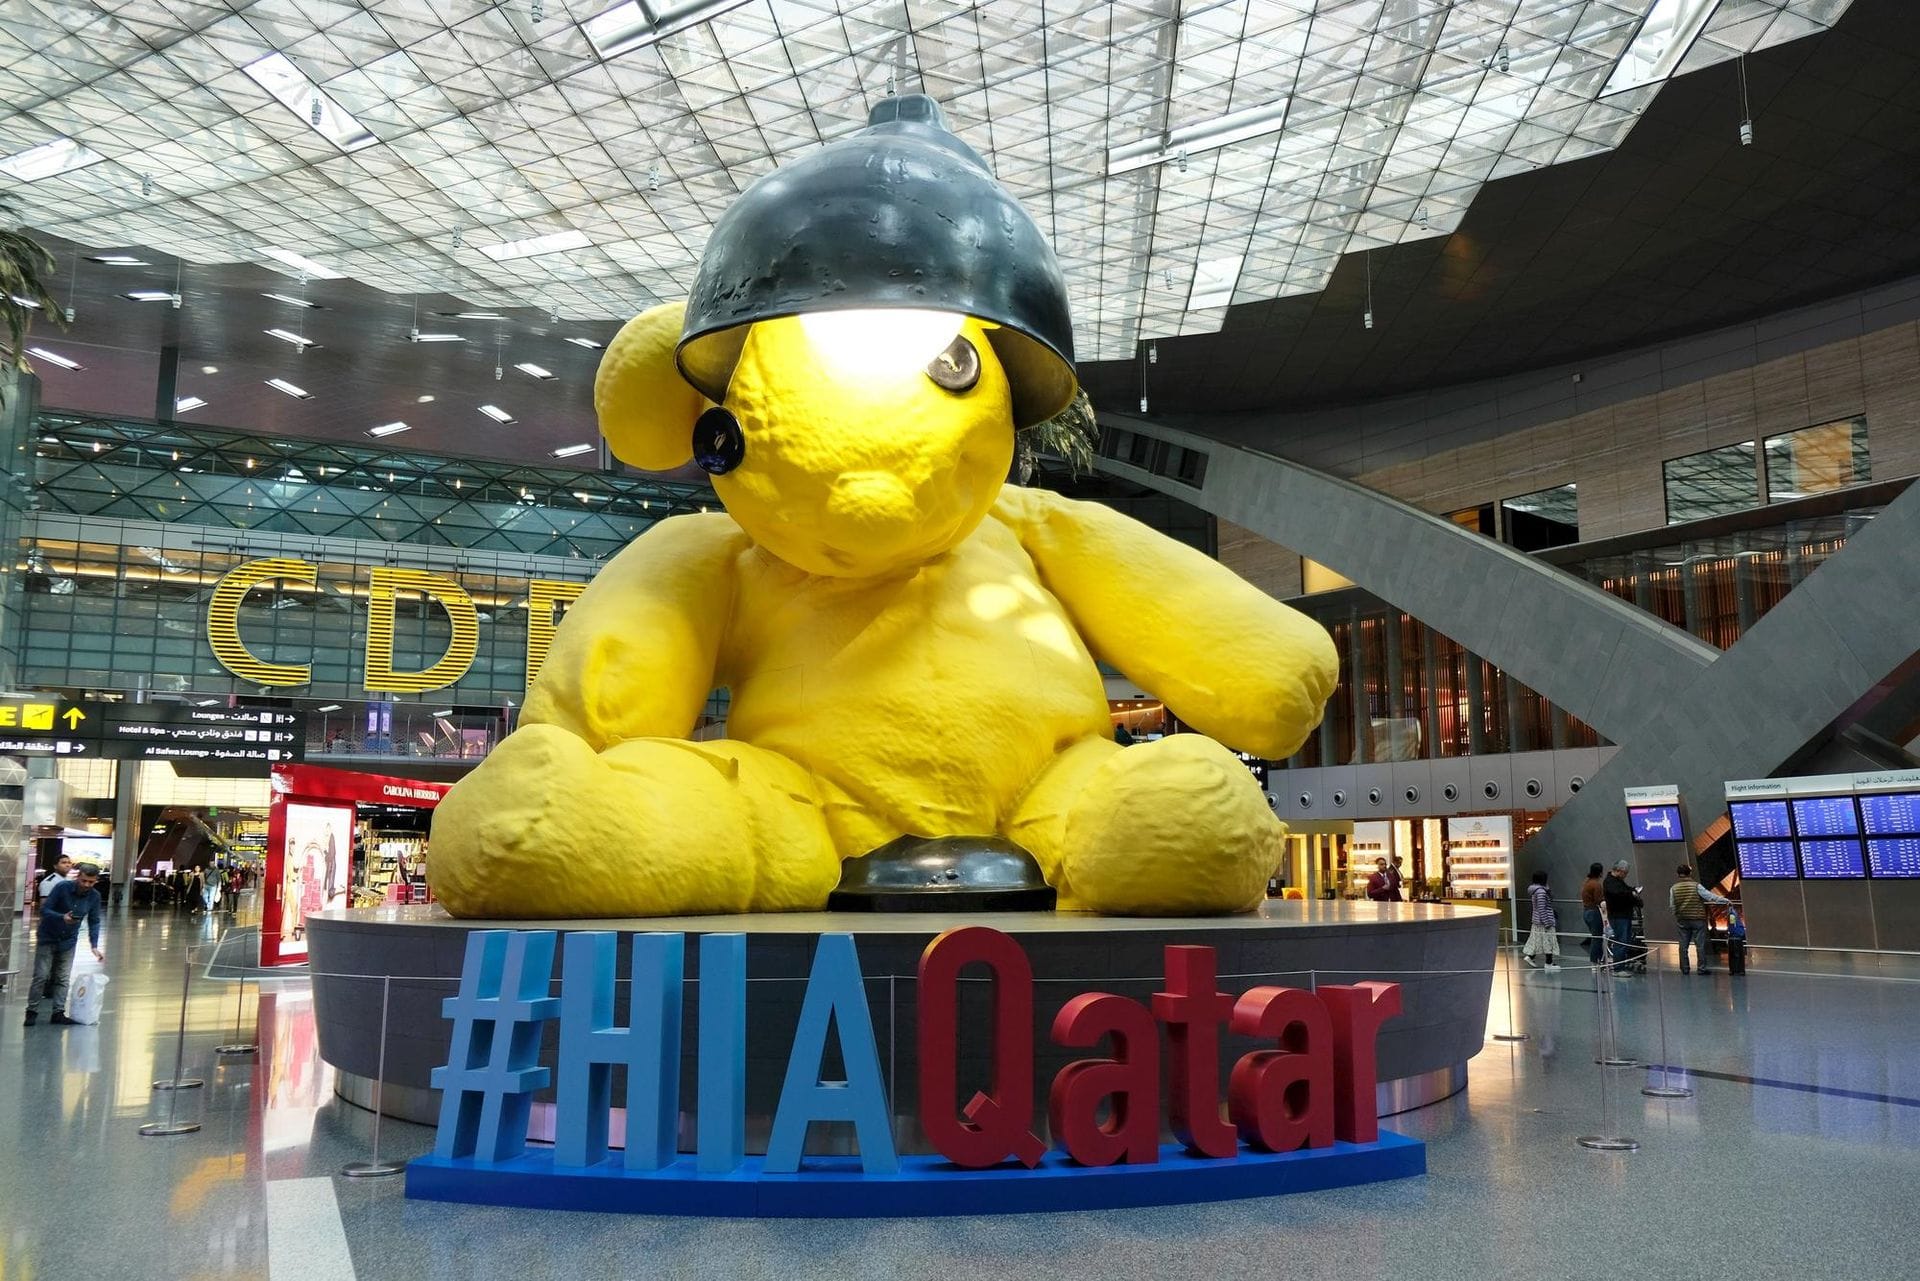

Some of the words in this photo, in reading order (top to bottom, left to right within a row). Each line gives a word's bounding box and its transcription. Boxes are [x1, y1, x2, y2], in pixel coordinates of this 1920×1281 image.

[207, 558, 318, 688] C
[363, 566, 480, 693] D
[192, 711, 225, 721] Lounges
[230, 713, 259, 721] صالات
[119, 726, 141, 734] Hotel
[150, 727, 166, 736] Spa
[155, 748, 179, 756] Safwa
[181, 749, 209, 758] Lounge
[383, 784, 413, 798] CAROLINA
